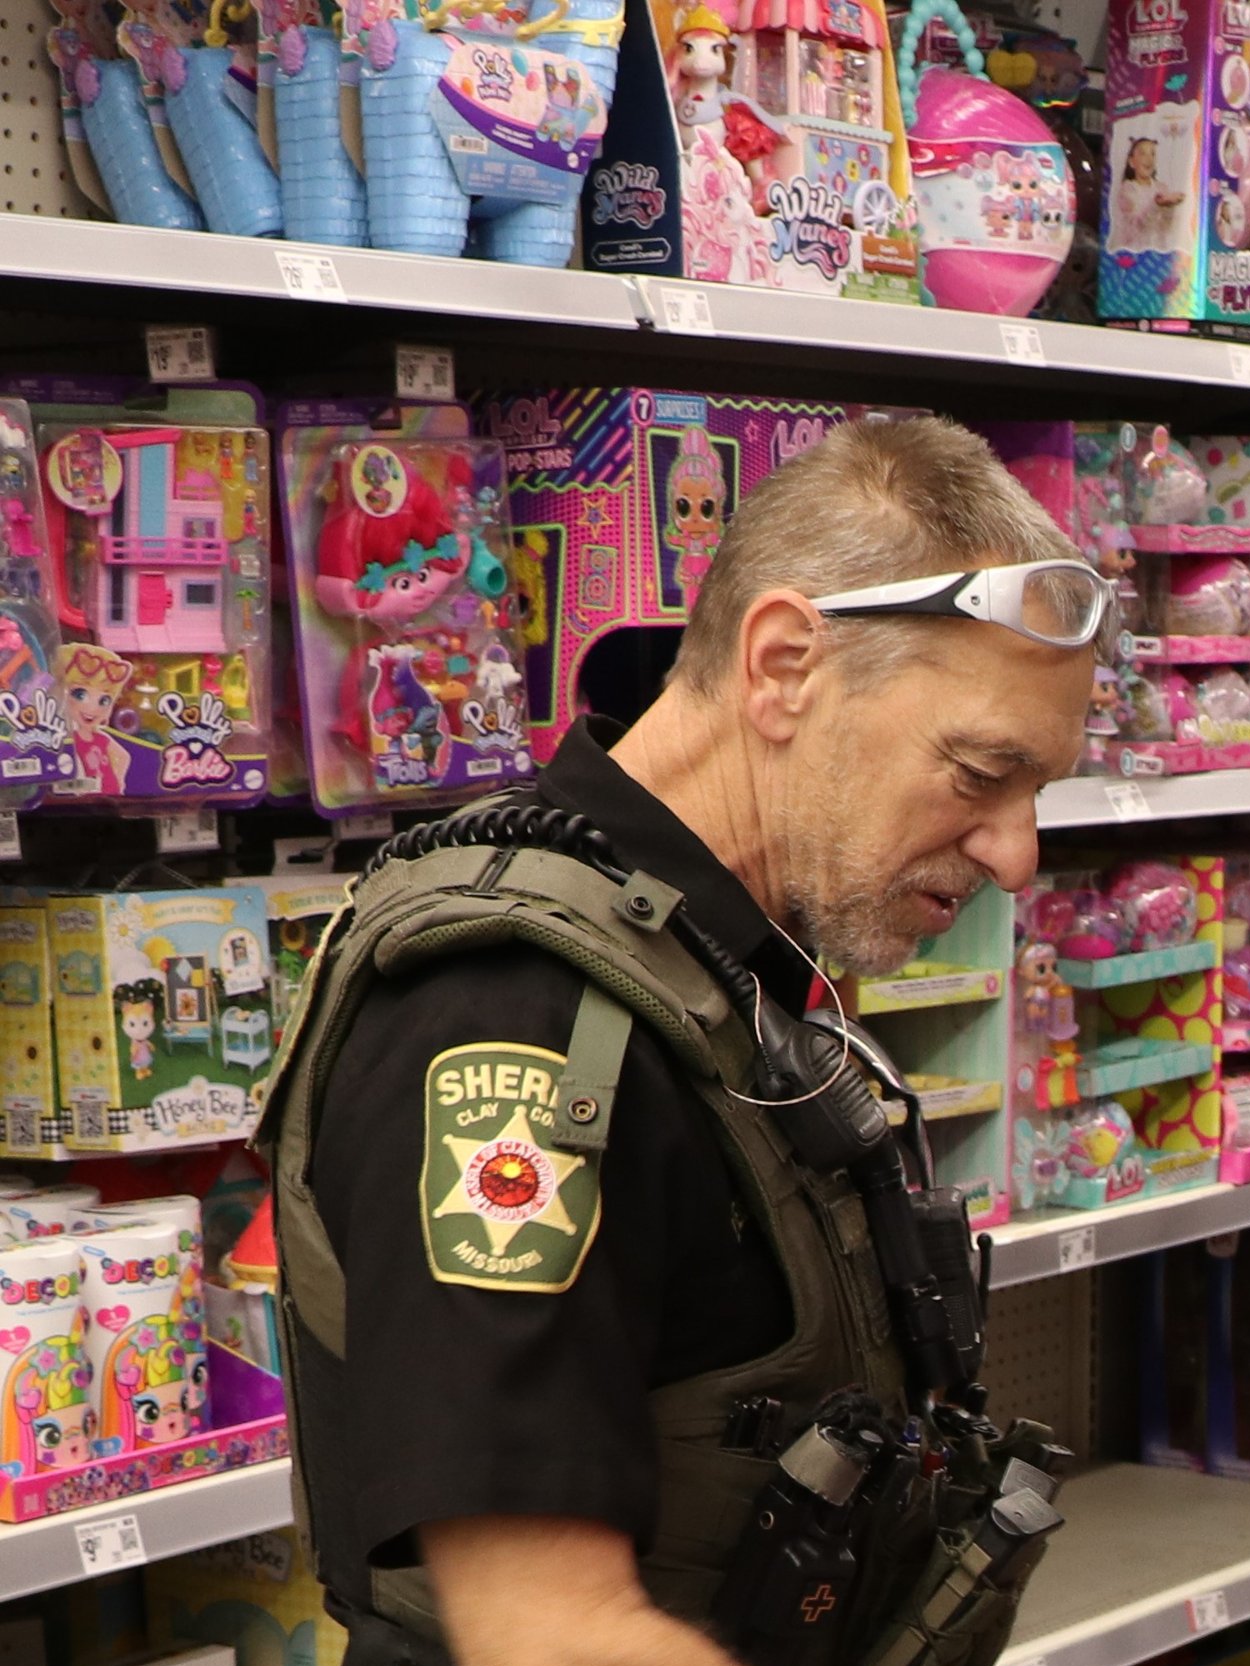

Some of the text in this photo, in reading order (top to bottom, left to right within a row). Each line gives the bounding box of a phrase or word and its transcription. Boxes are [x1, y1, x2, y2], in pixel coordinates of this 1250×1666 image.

[769, 180, 842, 222] Wild
[508, 448, 572, 470] POP-STARS
[158, 692, 231, 745] Polly
[463, 698, 522, 739] Polly
[163, 747, 232, 785] Barbie
[157, 1090, 238, 1122] Honey Bee
[456, 1102, 555, 1128] CLAY CO
[452, 1240, 543, 1274] MISSOURI
